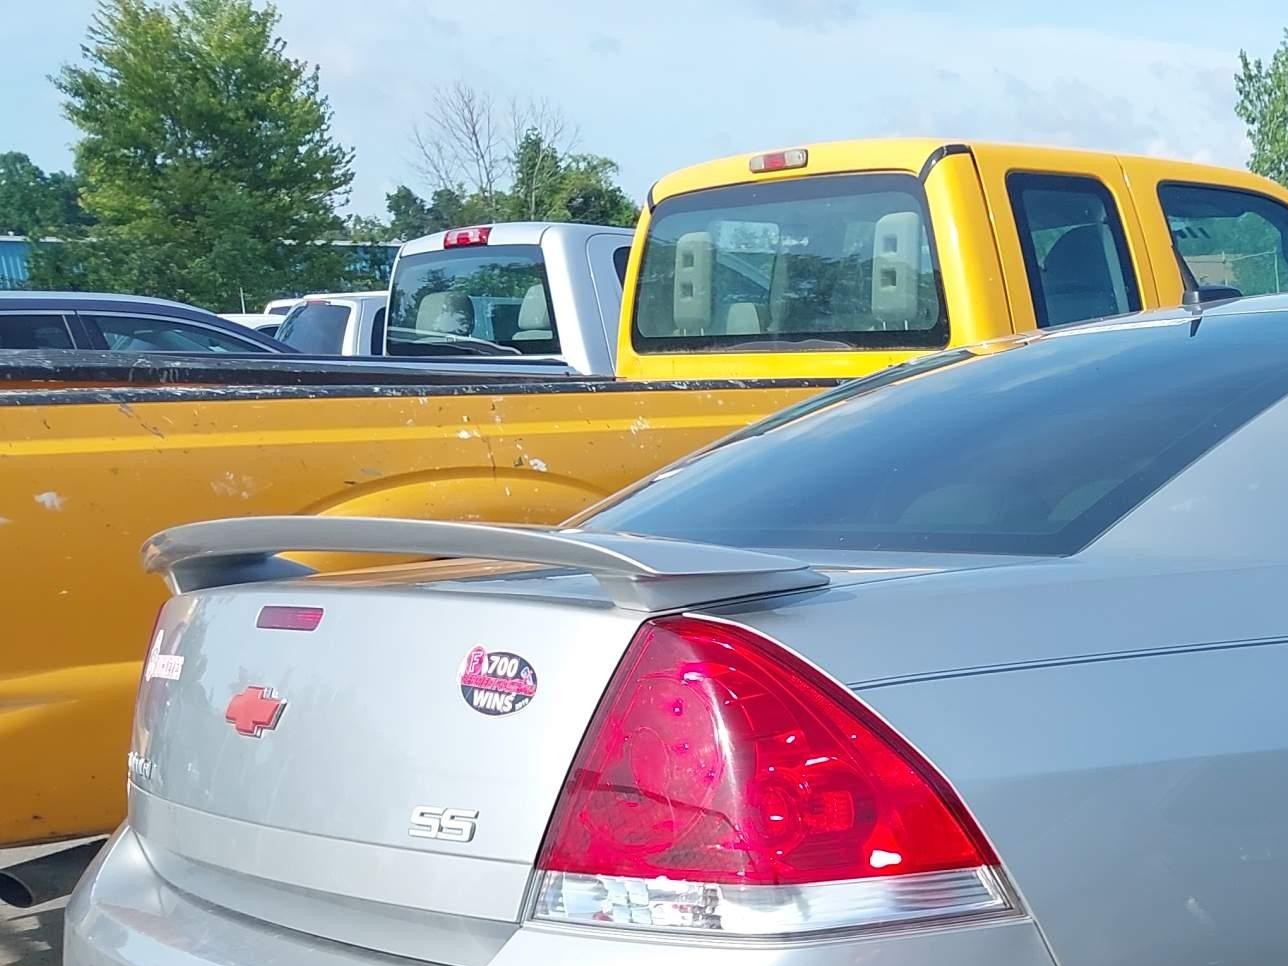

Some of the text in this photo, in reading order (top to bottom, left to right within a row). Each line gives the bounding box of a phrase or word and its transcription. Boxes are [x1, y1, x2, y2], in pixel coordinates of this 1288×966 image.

[487, 655, 520, 678] 700
[473, 689, 515, 713] WINS
[407, 805, 480, 843] SS
